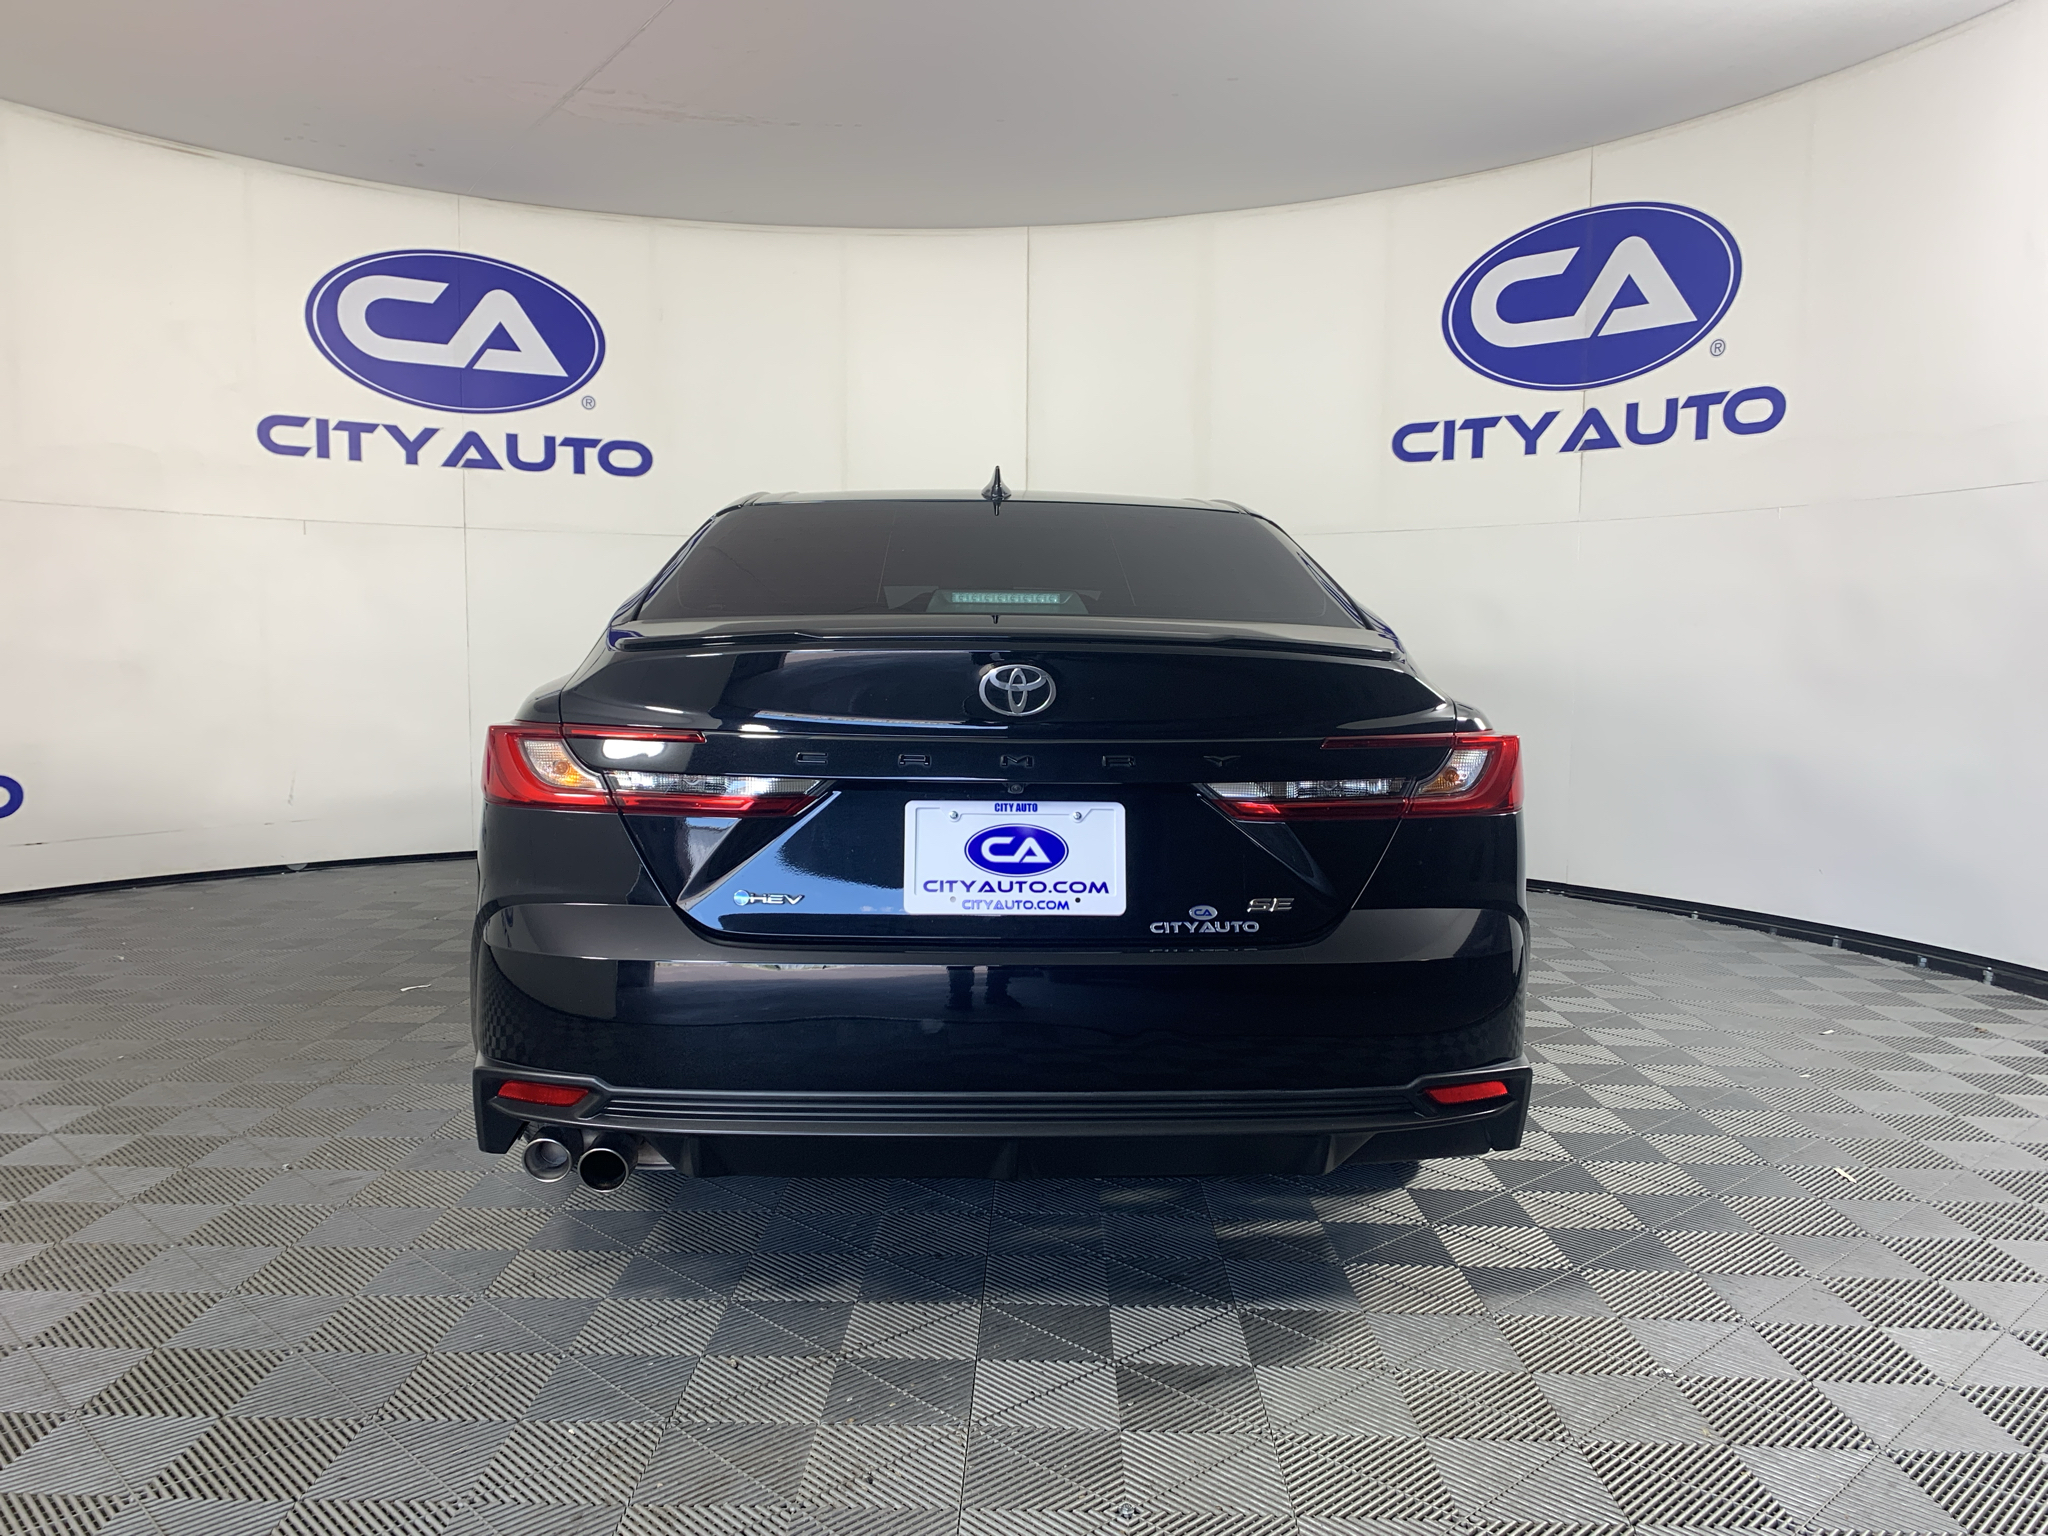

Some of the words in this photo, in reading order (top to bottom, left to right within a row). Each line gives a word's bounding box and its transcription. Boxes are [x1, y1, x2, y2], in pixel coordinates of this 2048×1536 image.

[1470, 235, 1698, 349] CA
[336, 274, 569, 378] CA
[994, 803, 1014, 813] CITY
[1015, 803, 1038, 813] AUTO
[981, 836, 1052, 863] CA
[922, 879, 1110, 895] CITYAUTO.COM
[749, 893, 805, 905] HEV
[961, 899, 1070, 911] CITYAUTO.COM
[1247, 898, 1294, 912] SE
[1193, 908, 1213, 917] CA
